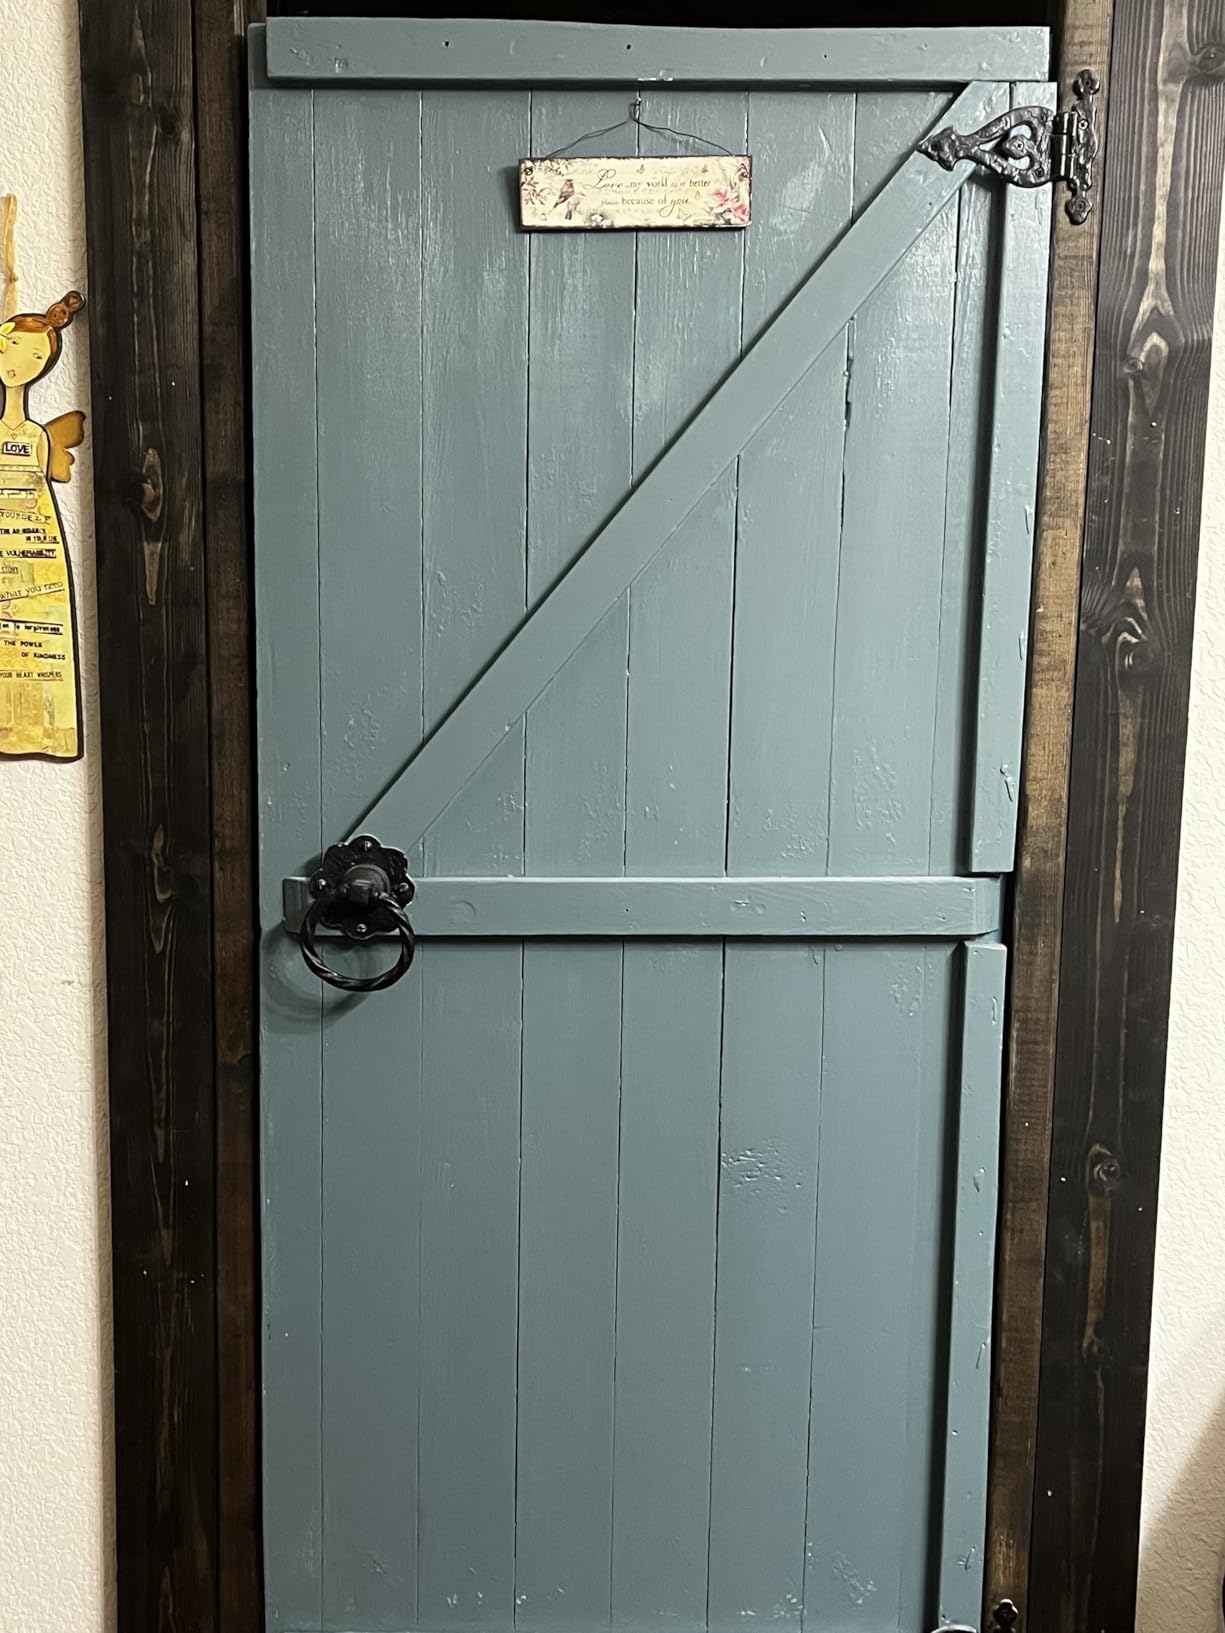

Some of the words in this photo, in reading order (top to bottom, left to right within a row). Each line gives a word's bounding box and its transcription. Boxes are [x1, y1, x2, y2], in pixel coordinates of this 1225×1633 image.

[646, 177, 668, 188] world
[689, 179, 711, 187] better
[621, 196, 655, 205] because
[657, 194, 667, 205] of
[659, 198, 689, 217] you
[5, 443, 30, 453] LOVE
[24, 585, 42, 597] you
[20, 640, 42, 648] POWER
[33, 652, 66, 660] KINDNESS
